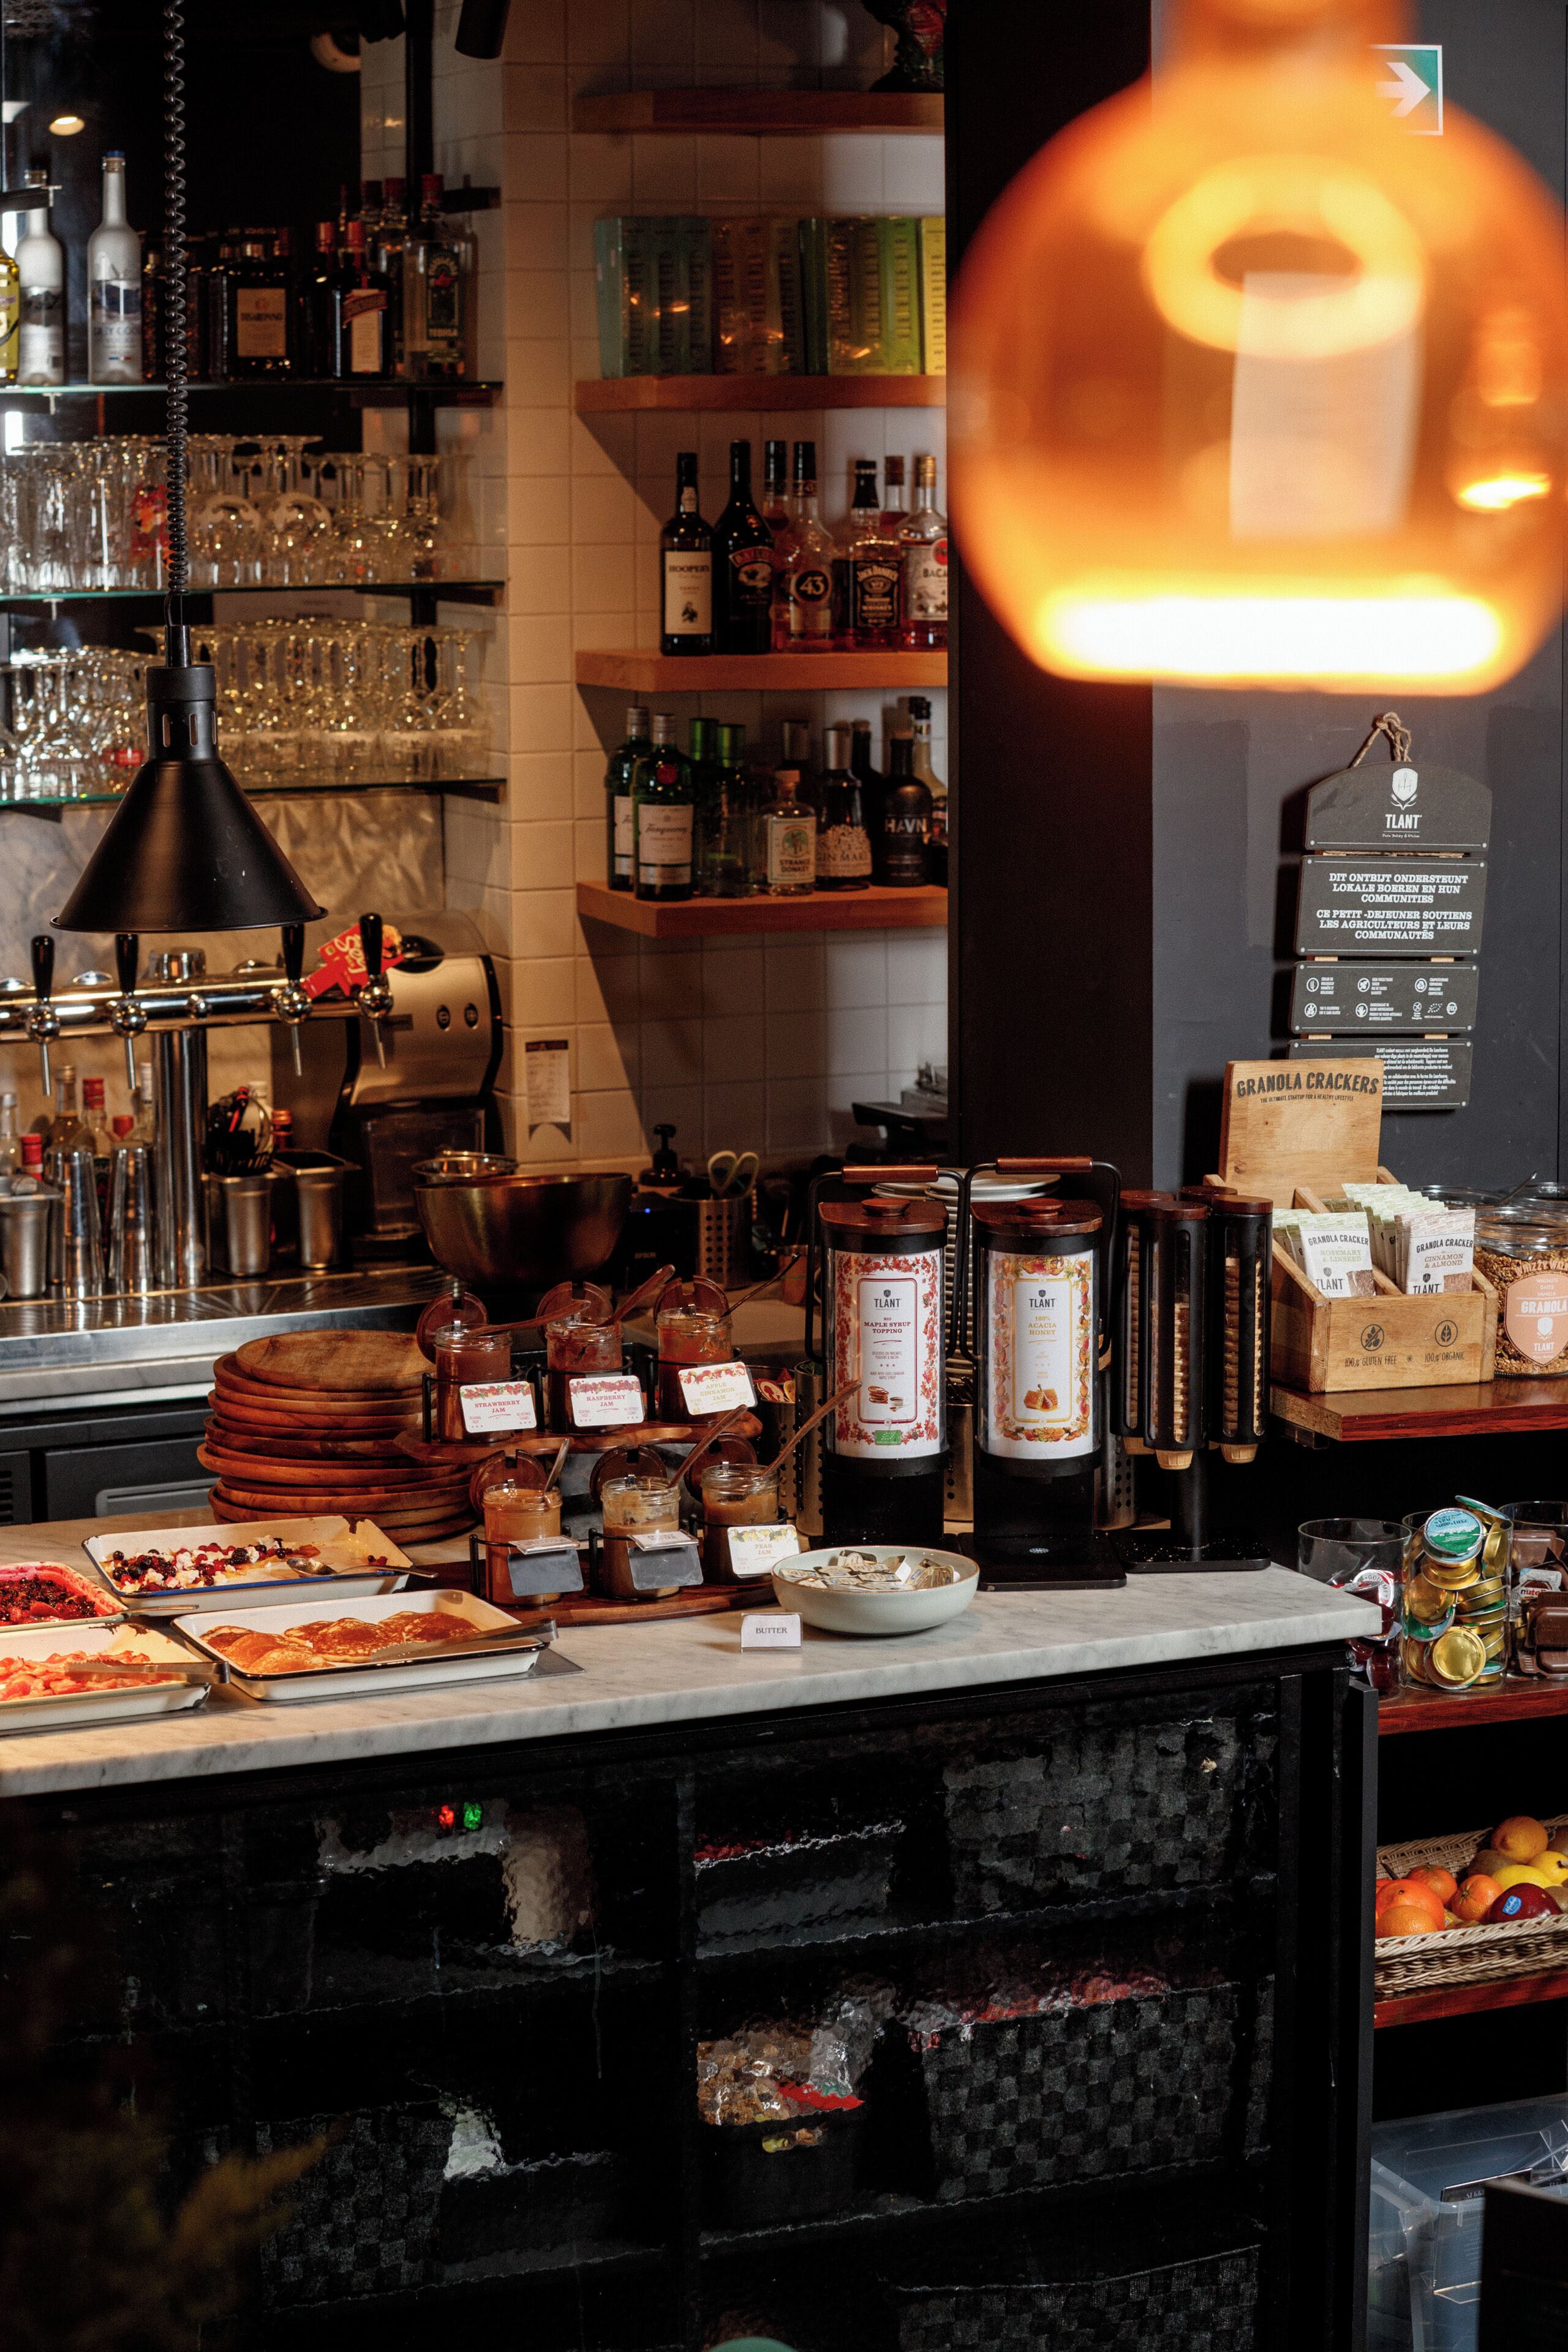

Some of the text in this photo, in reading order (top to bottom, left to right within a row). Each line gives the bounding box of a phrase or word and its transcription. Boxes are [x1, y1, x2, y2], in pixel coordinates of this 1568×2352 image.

[799, 576, 825, 595] 43
[884, 818, 927, 834] HAVN
[1385, 814, 1420, 829] TLANT
[1329, 873, 1468, 883] DIT ONTBIJT ONDERSTEUNT
[1332, 883, 1461, 894] LOKALE BOEREN EN HUN
[1361, 894, 1433, 903] COMMUNITIES
[1316, 910, 1330, 918] CE
[1422, 911, 1472, 920] SOUTIENS
[1319, 920, 1340, 929] LES
[1341, 920, 1420, 929] AGRICULTEURS
[1436, 921, 1470, 930] LEURS
[1355, 929, 1434, 940] COMMUNAUTÉS
[1237, 1072, 1379, 1098] GRANOLA CRACKERS
[1308, 1234, 1368, 1246] GRANOLA CRACKER
[1416, 1238, 1473, 1253] GRANOLA CRACKER
[1425, 1253, 1463, 1262] CINNAMON
[1431, 1260, 1463, 1268] ALMOND
[1316, 1278, 1343, 1290] TLANT
[874, 1298, 900, 1308] TLANT
[1029, 1298, 1055, 1308] TLANT
[1521, 1299, 1567, 1314] GRANOLA
[1534, 1342, 1555, 1352] TLANT
[1345, 1355, 1396, 1367] 100% GLUTEN FREE
[1425, 1351, 1465, 1362] 100% ORGANIC
[700, 1387, 735, 1396] CINNAMON
